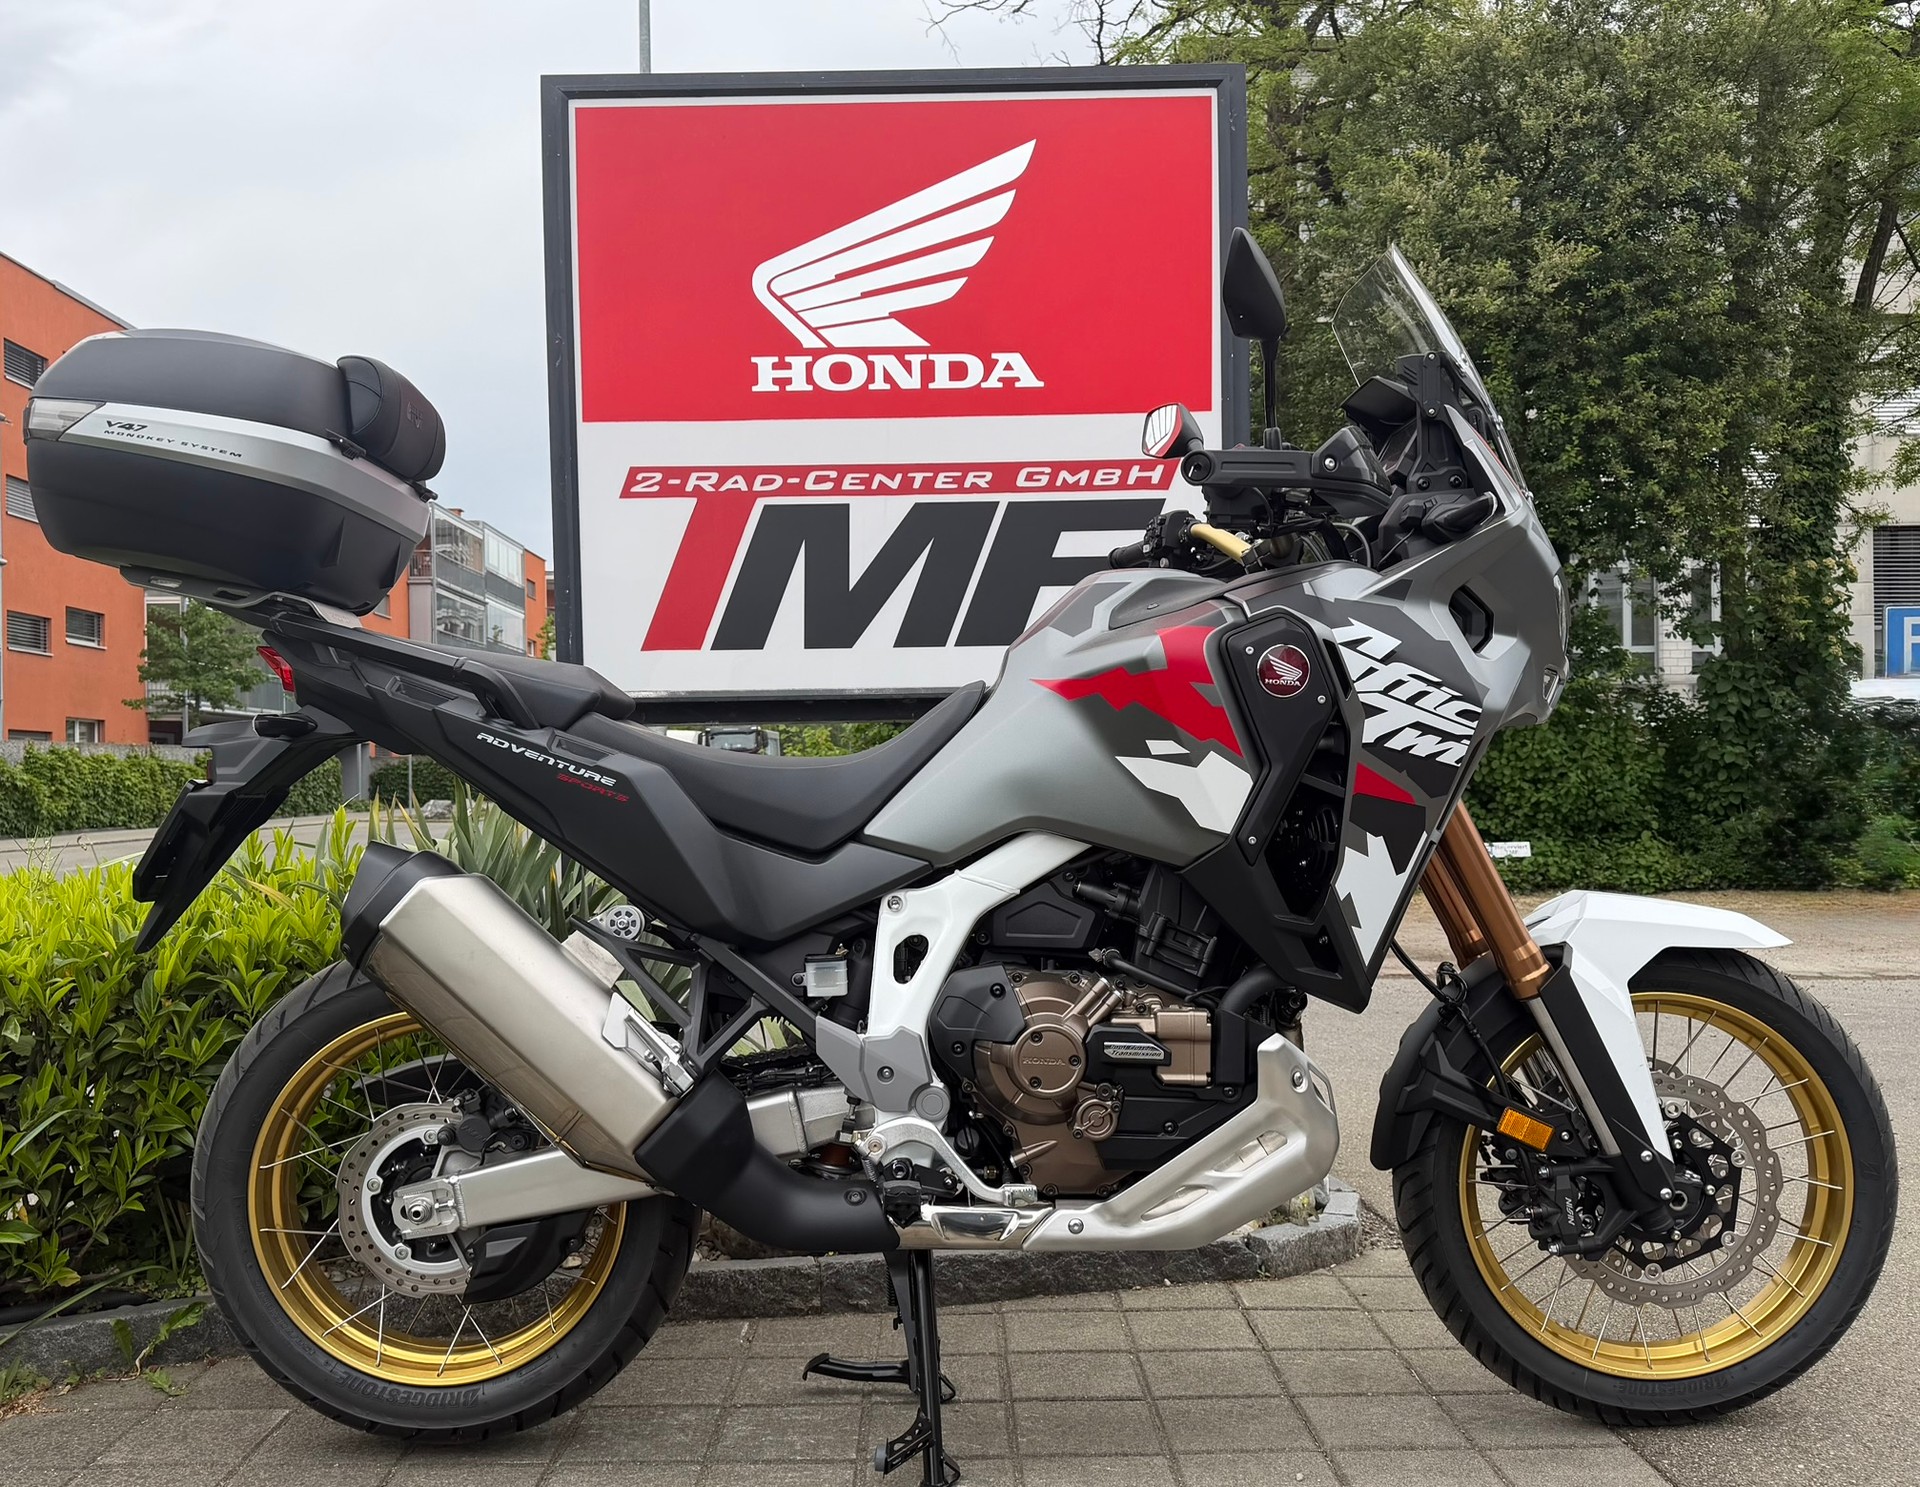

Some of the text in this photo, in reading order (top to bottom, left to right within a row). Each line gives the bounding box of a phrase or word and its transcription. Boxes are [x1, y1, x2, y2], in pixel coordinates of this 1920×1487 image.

[750, 352, 1045, 392] HONDA
[106, 420, 148, 432] V47
[104, 430, 243, 458] MONOKEY SYSTEM
[638, 498, 1167, 651] TMF
[1264, 678, 1302, 687] HONDA
[476, 732, 617, 787] ADVENTURE
[556, 773, 630, 803] SPORTS
[1022, 1057, 1066, 1066] HONDA
[1111, 1050, 1162, 1058] Transmission
[336, 1371, 481, 1409] BRIDGESTONE
